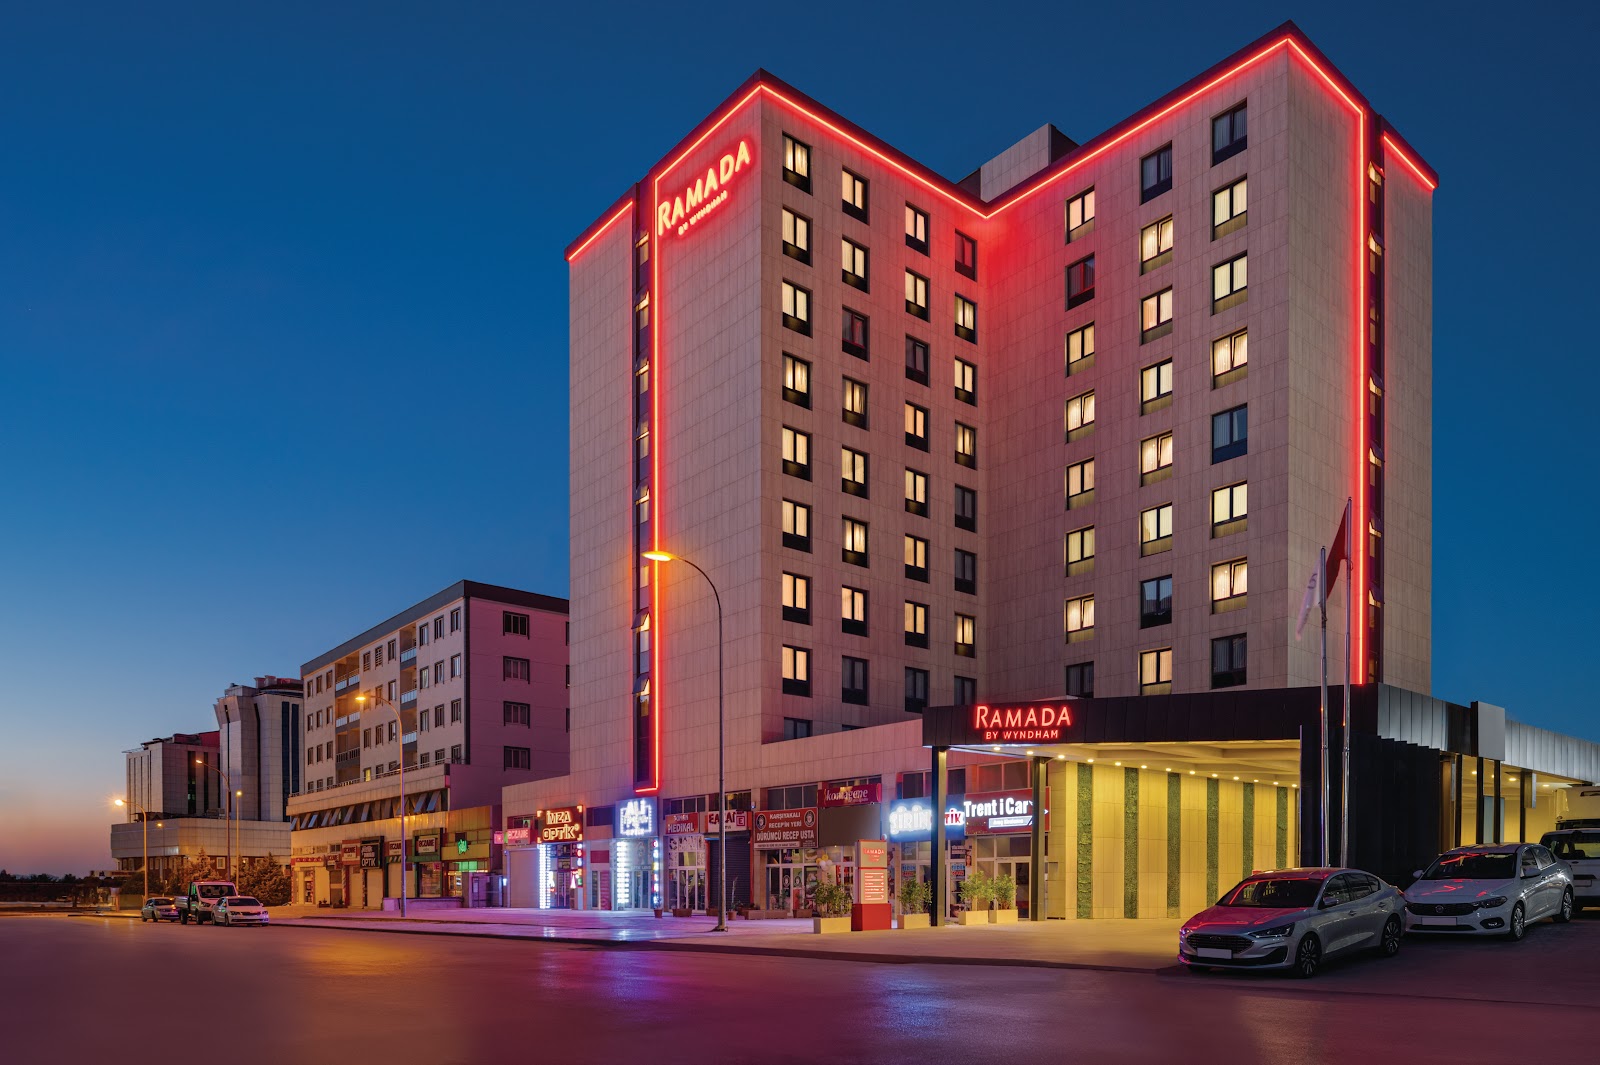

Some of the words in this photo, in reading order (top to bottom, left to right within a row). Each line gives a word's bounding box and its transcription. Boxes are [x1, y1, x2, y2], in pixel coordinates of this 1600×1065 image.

[657, 140, 750, 236] RAMADA
[975, 705, 1071, 729] RAMADA
[986, 731, 998, 740] BY
[1003, 730, 1059, 740] WYNDHAM
[964, 801, 997, 817] Trent
[1005, 797, 1028, 814] Car
[782, 831, 799, 840] RECEP
[800, 830, 814, 839] USTA
